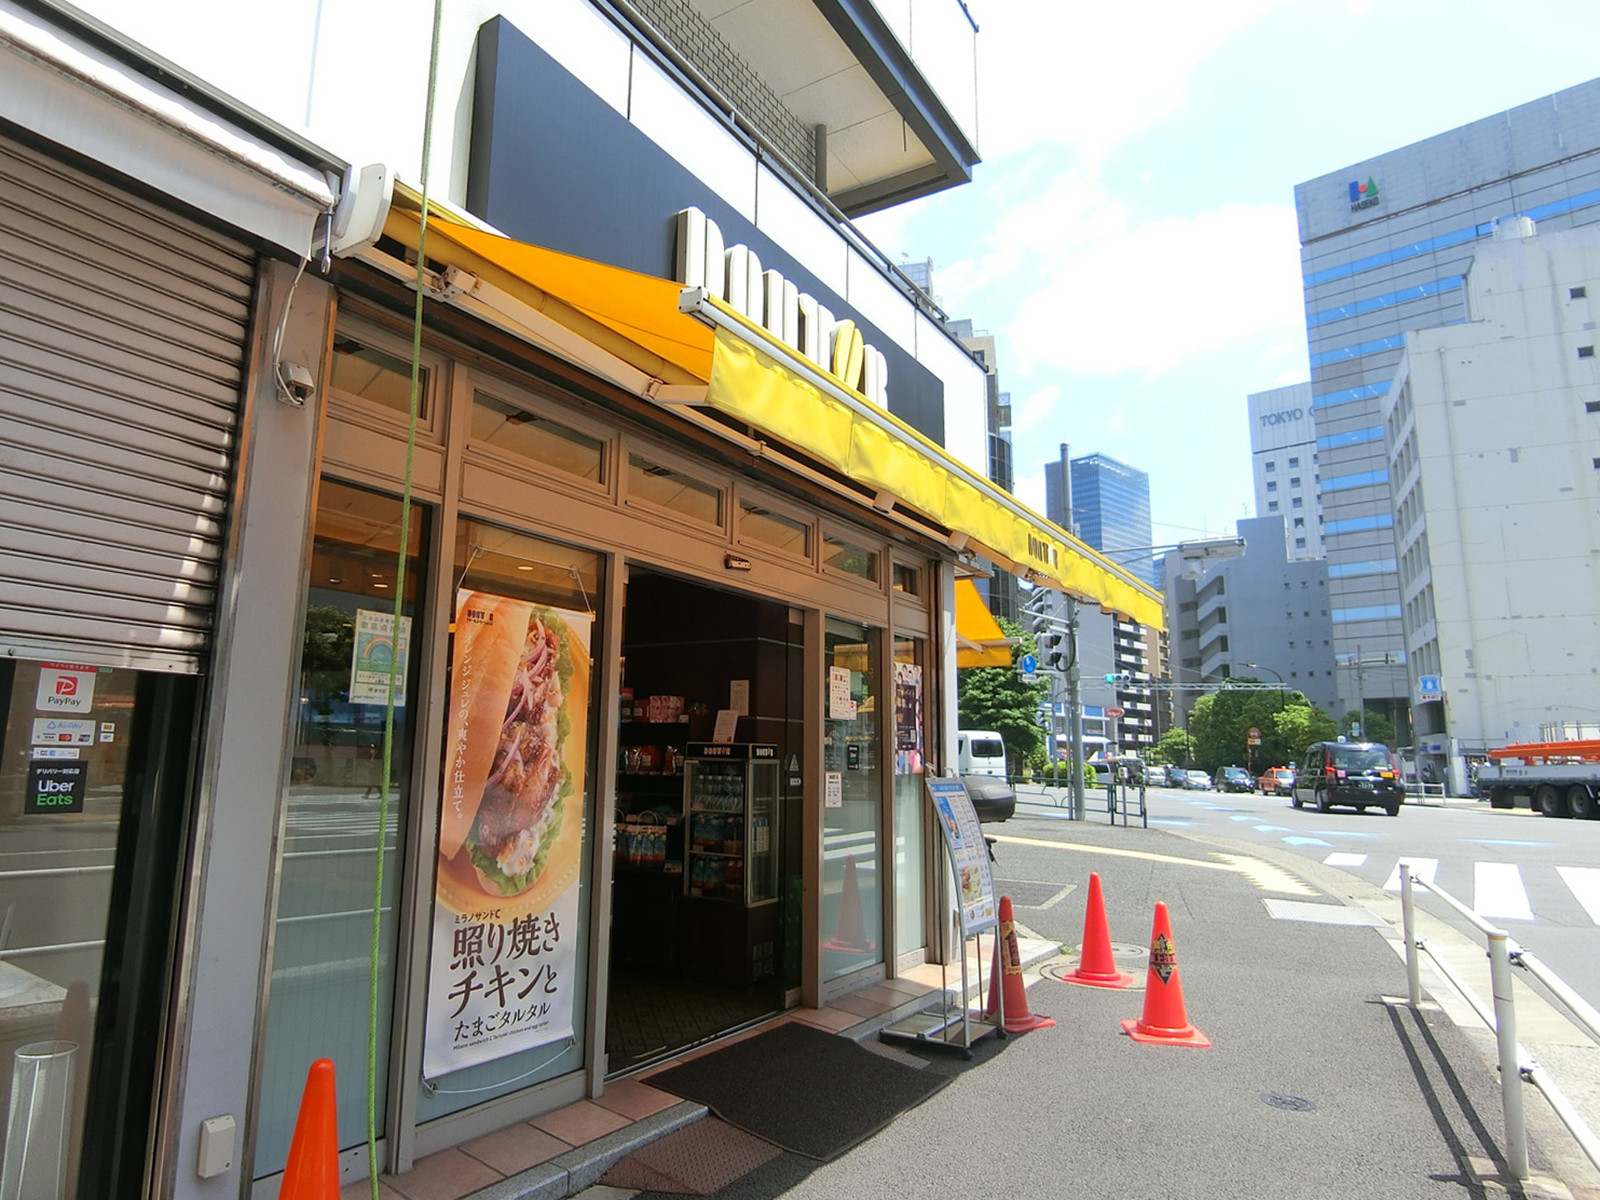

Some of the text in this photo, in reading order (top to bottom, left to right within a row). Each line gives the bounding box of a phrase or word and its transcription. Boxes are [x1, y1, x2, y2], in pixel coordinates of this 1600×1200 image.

[1260, 408, 1304, 427] TOKYO
[47, 696, 82, 706] PayPay
[38, 780, 75, 792] Uber
[36, 794, 73, 806] Eats
[454, 909, 501, 924] ミラノサンドC
[450, 911, 560, 970] 照り焼き
[448, 964, 558, 1019] チキンと
[454, 1002, 550, 1042] たまごタルタル
